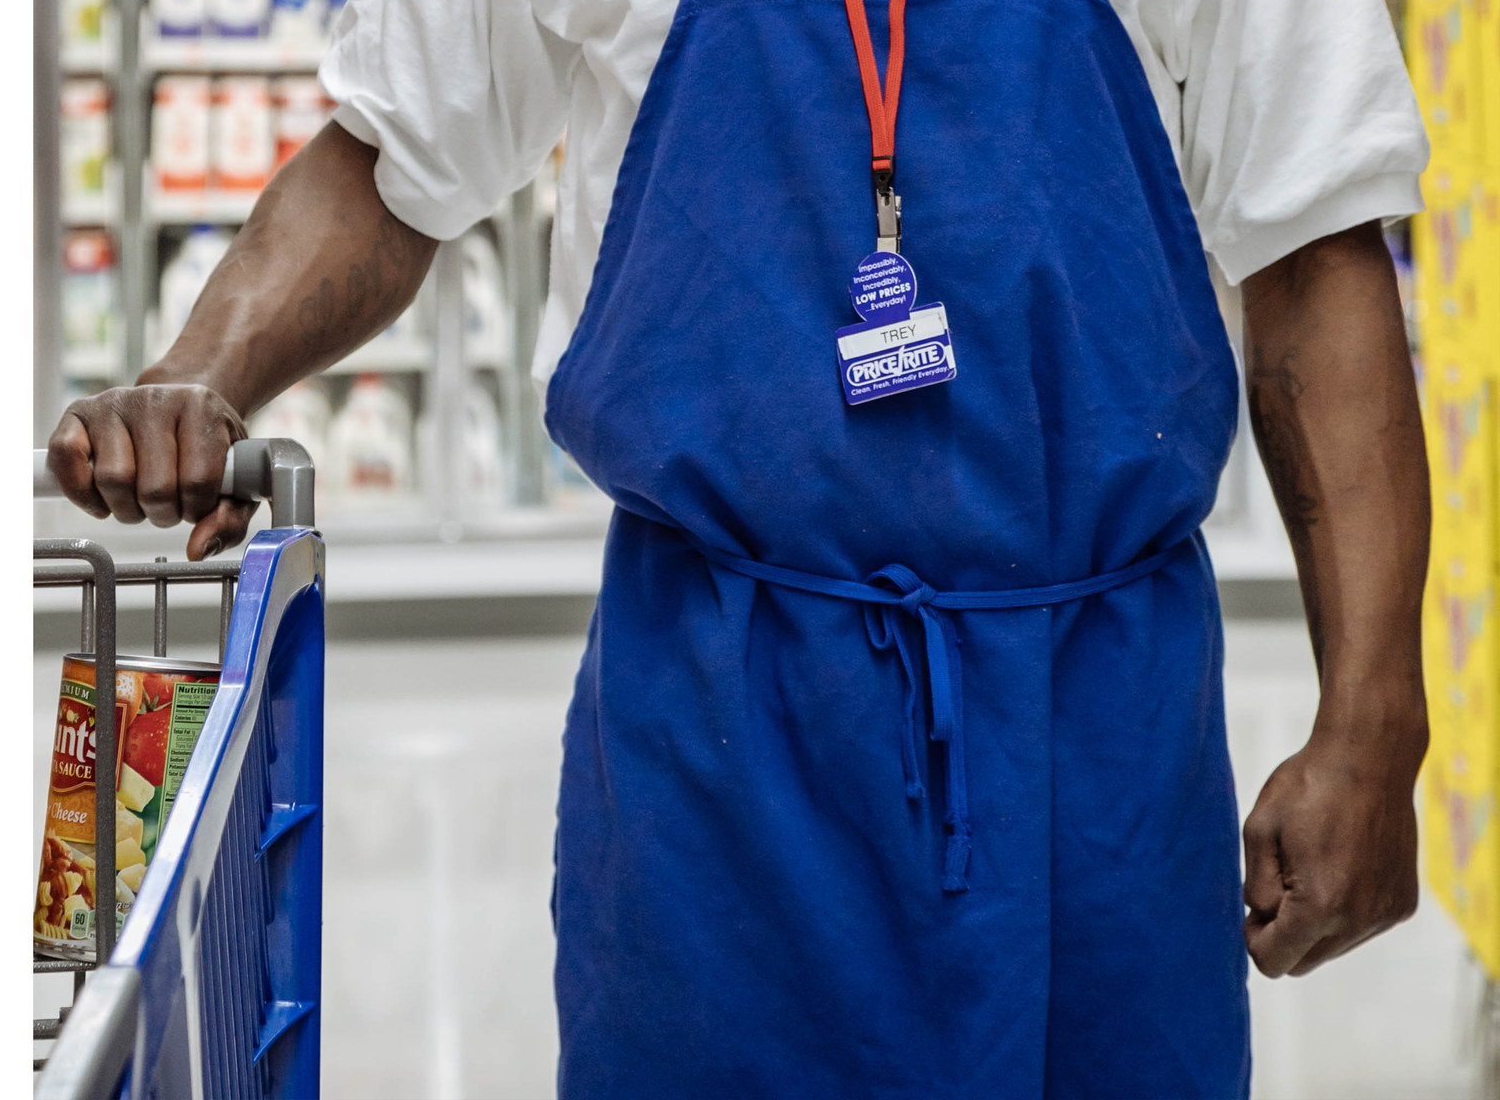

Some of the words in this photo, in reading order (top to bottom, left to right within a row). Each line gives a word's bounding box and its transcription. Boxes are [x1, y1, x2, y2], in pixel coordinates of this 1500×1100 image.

[855, 291, 877, 305] LOW
[879, 282, 911, 299] PRICES
[880, 324, 916, 343] TREY
[892, 374, 917, 385] Friendly
[178, 686, 216, 694] Nutrition
[59, 761, 92, 779] SAUCE
[51, 802, 88, 824] Cheese
[75, 913, 85, 925] 60
